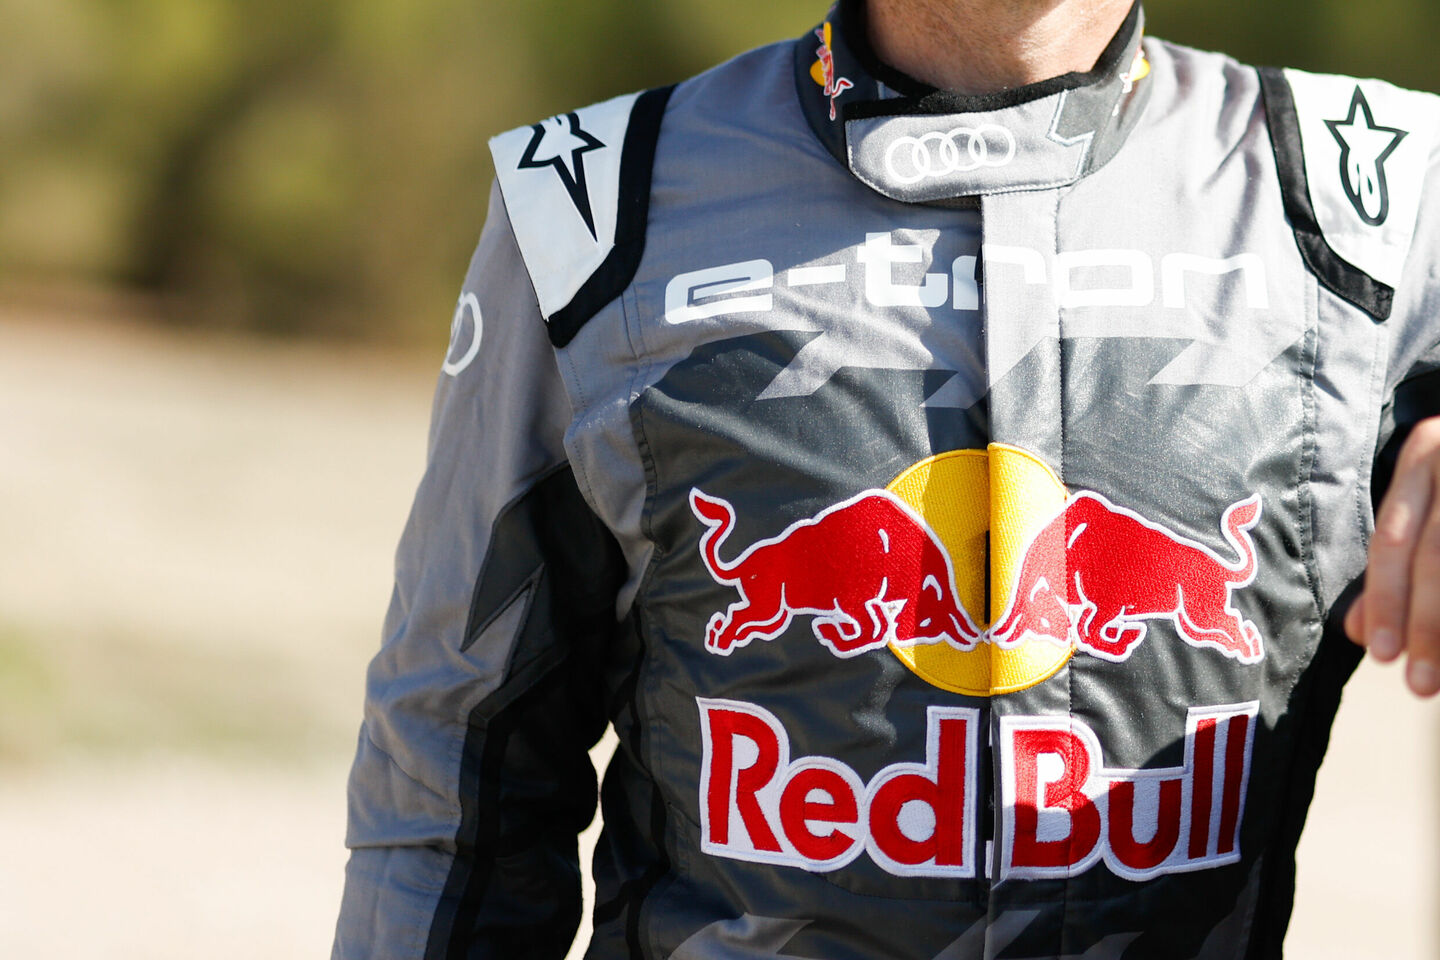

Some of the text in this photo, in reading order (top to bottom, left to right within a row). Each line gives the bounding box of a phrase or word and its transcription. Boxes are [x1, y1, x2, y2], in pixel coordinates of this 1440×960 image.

[664, 231, 1270, 325] e-tron
[701, 702, 1256, 876] Red Bull
